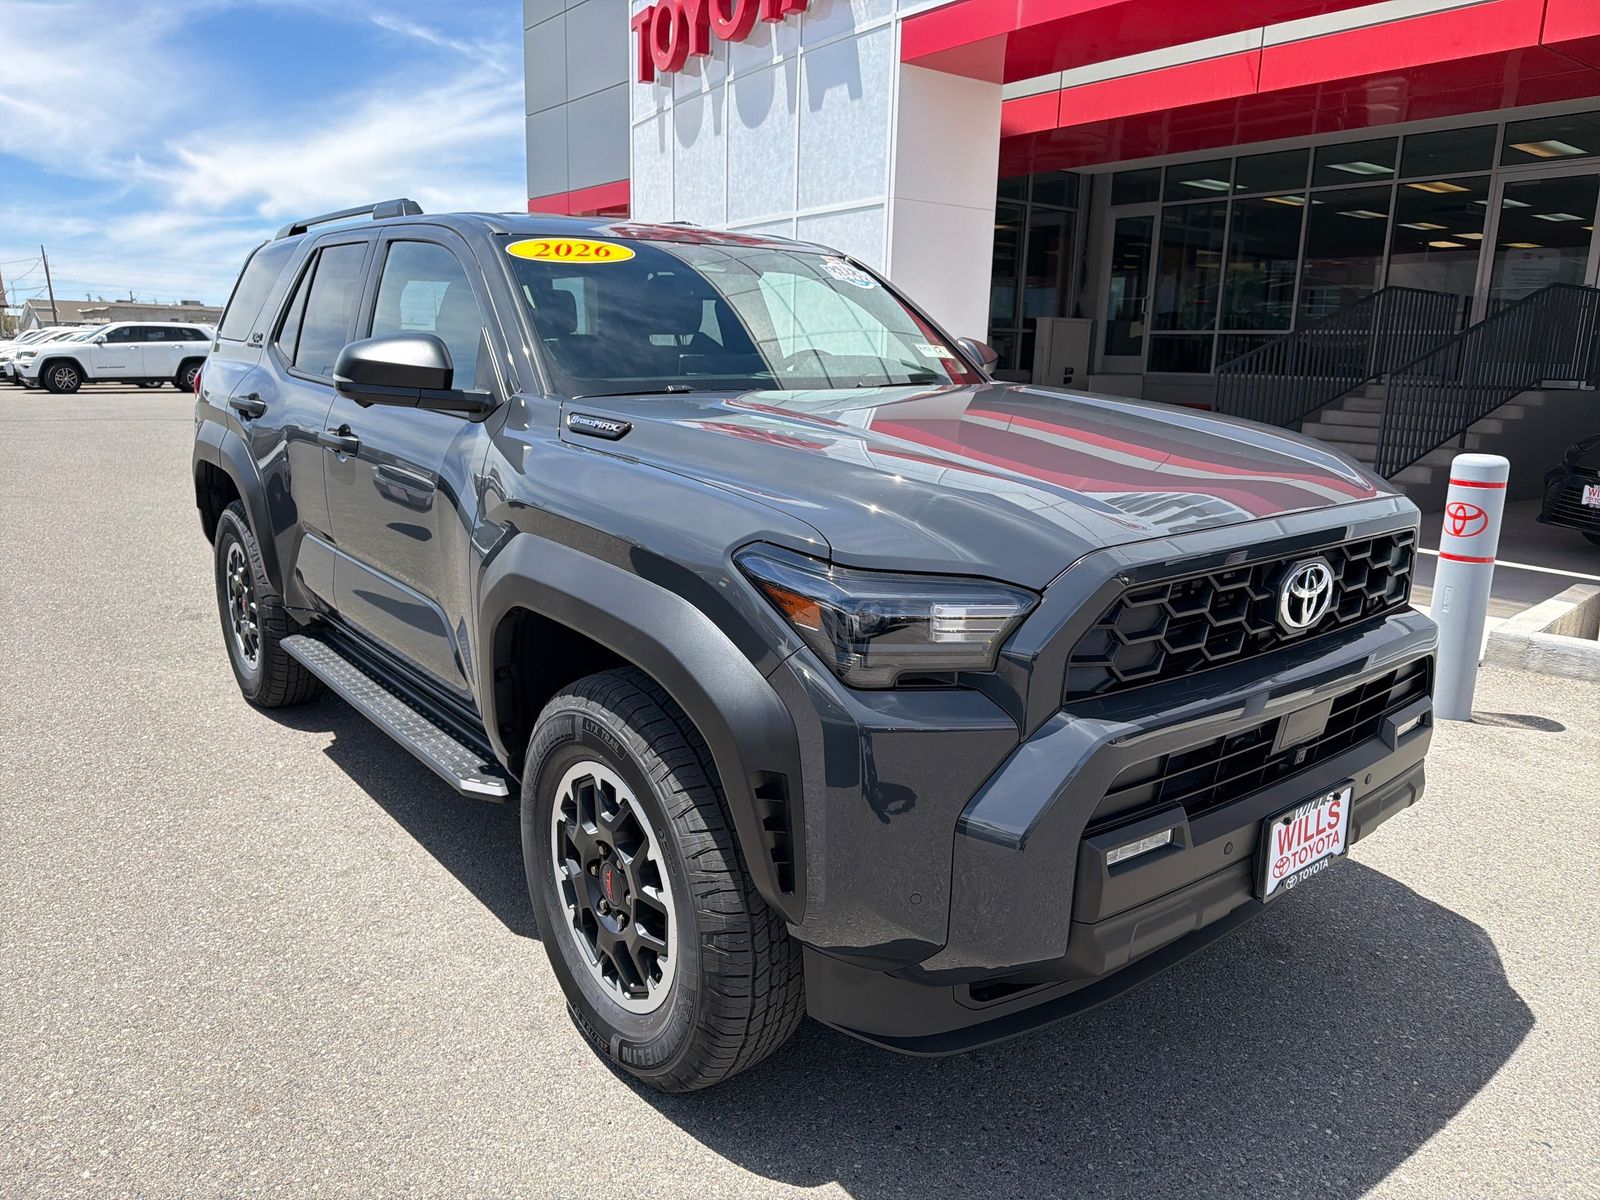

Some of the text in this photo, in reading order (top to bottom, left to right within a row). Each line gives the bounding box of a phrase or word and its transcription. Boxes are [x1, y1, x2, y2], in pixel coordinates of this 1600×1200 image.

[534, 242, 612, 258] 2026
[585, 720, 620, 754] LTX TRAIL
[1294, 792, 1335, 820] WILLS
[1277, 800, 1341, 856] WILLS
[1291, 830, 1340, 869] TOYOTA
[1300, 858, 1329, 881] TOYOTA
